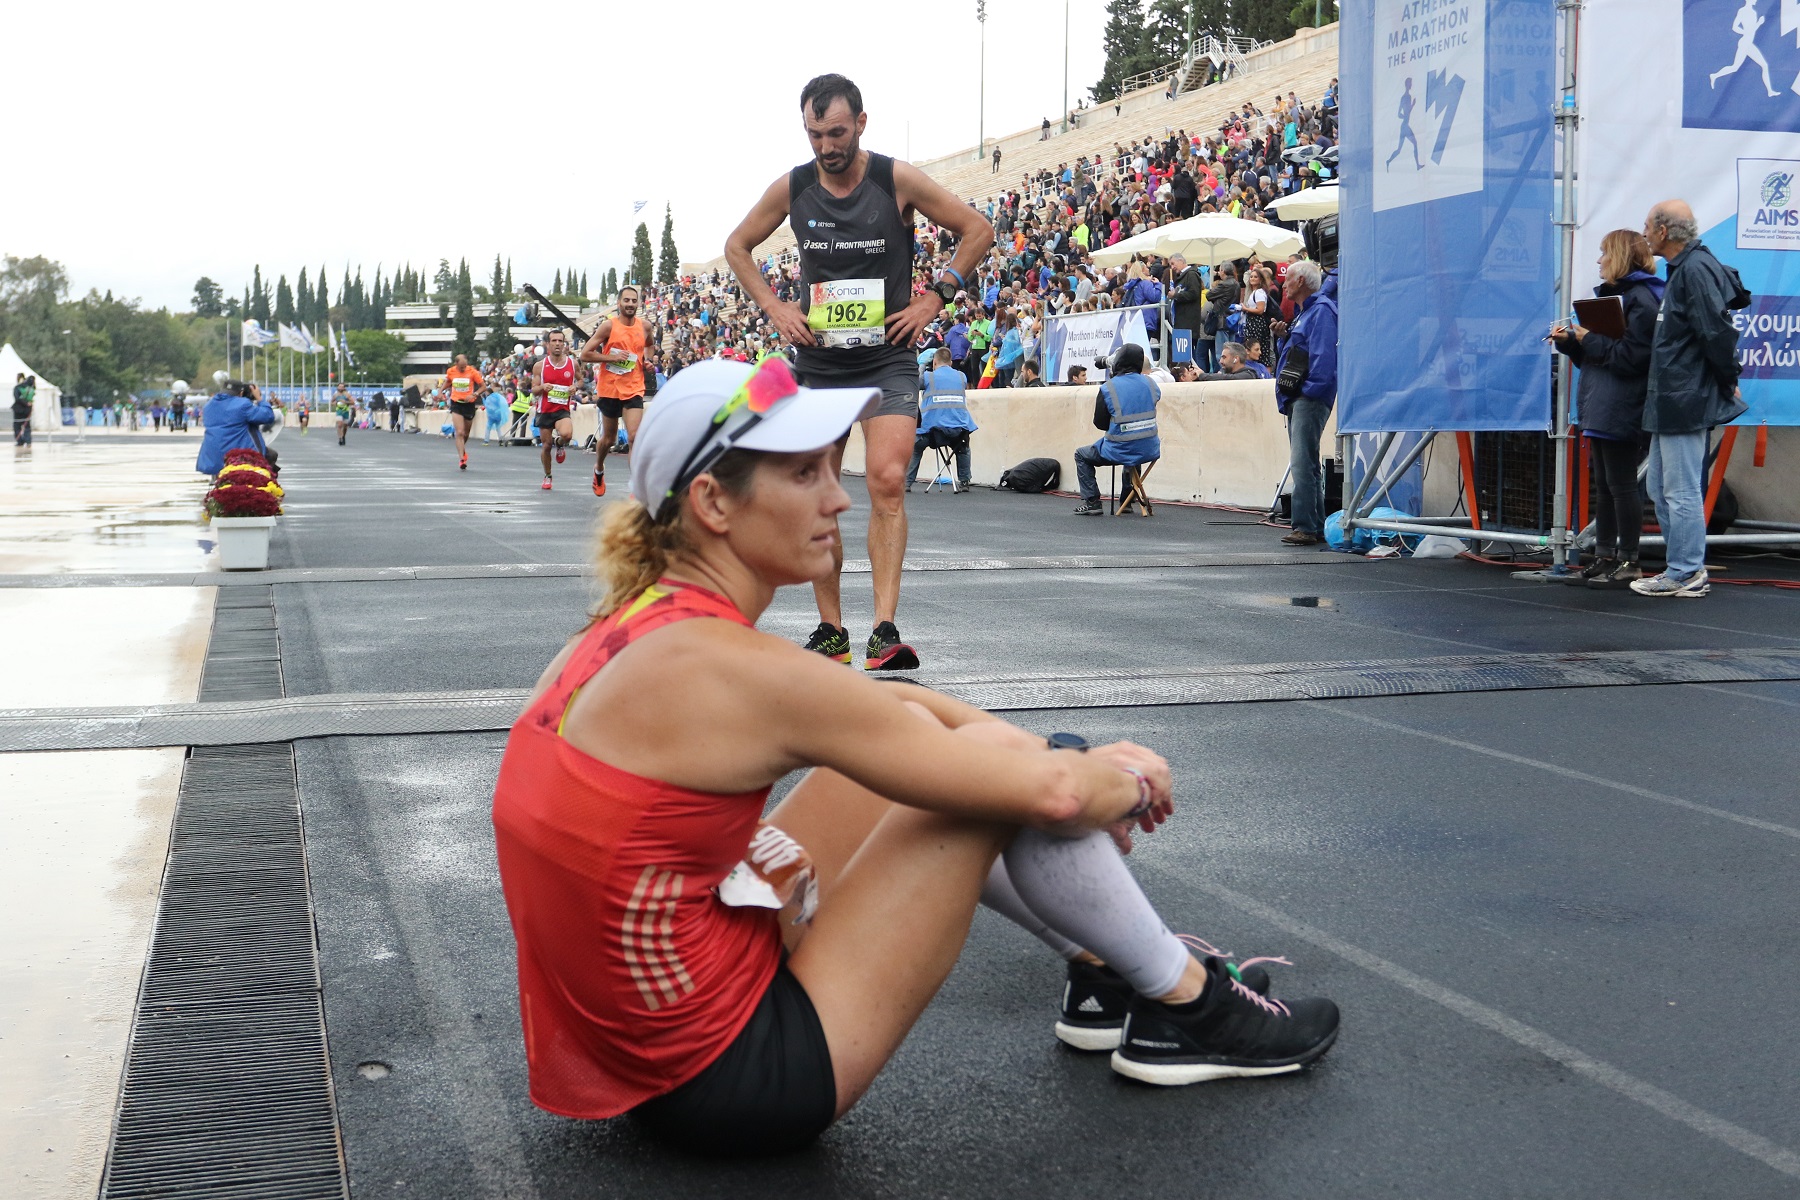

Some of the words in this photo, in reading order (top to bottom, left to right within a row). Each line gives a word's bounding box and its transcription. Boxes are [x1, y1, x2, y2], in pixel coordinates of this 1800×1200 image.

[1401, 0, 1457, 22] ATHE
[1388, 6, 1469, 50] MARATHON
[1387, 52, 1406, 68] THE
[1410, 31, 1468, 62] AUTHENTIC
[1754, 208, 1799, 226] AIMS
[835, 239, 886, 250] FRONTRUNNER
[826, 303, 867, 323] 1962
[1068, 329, 1091, 341] Marathon
[1095, 328, 1114, 339] Athens
[1068, 347, 1077, 358] The
[1078, 346, 1098, 358] Authentic
[1175, 337, 1188, 352] VIP
